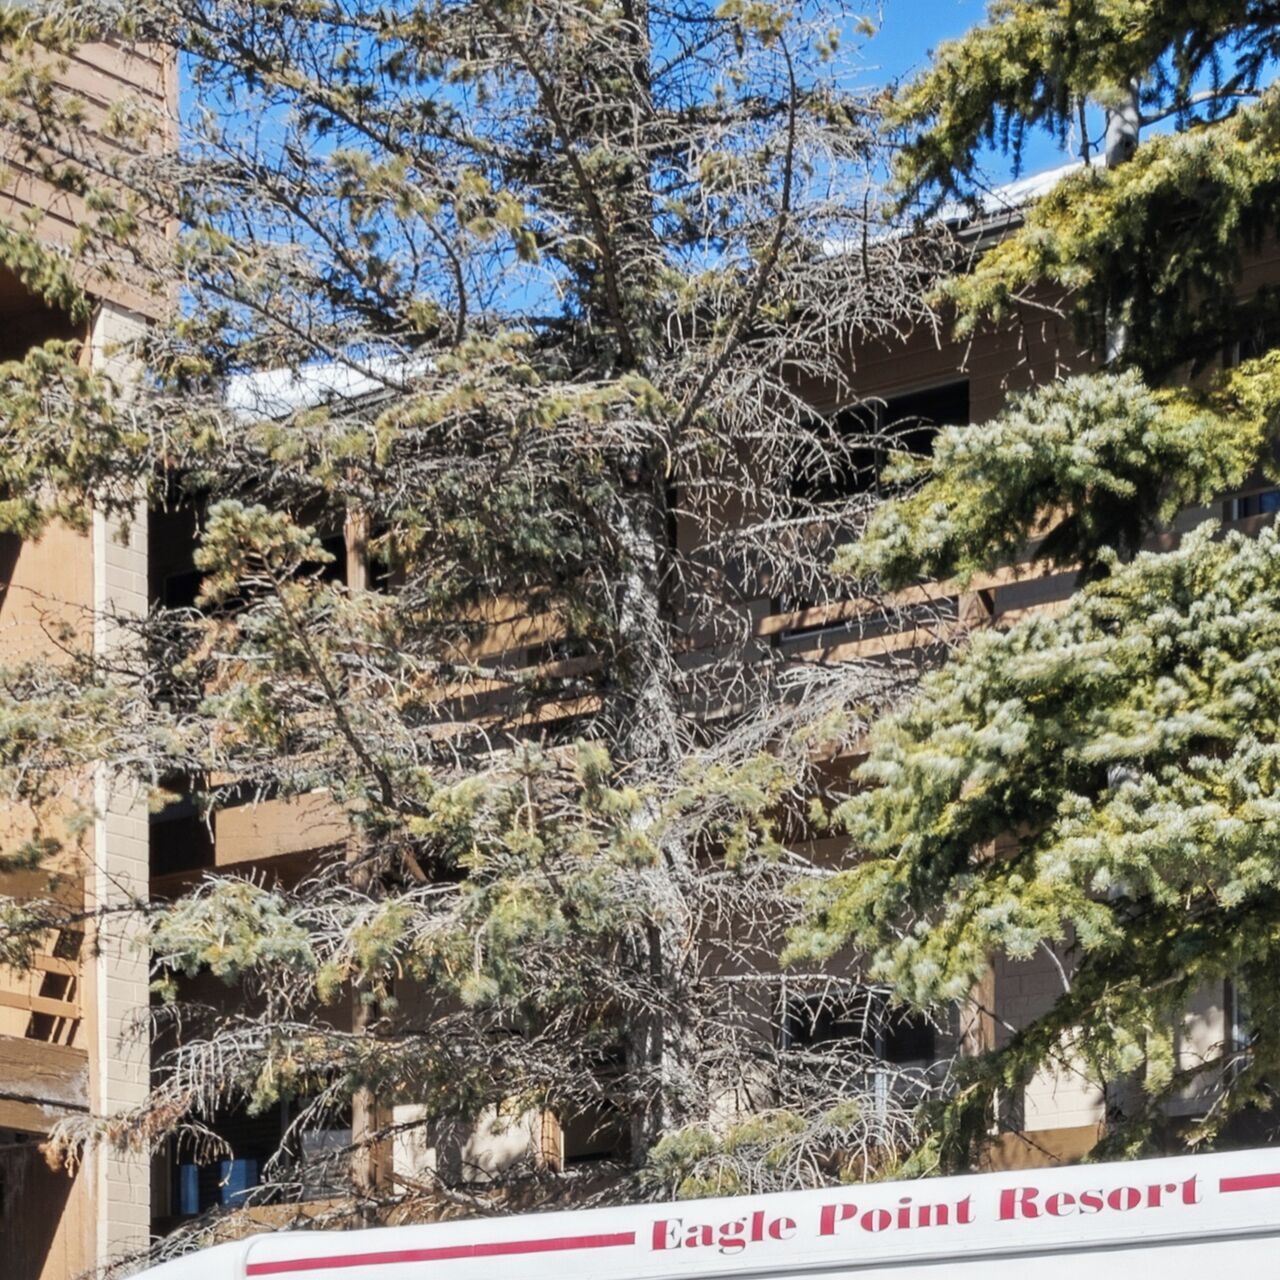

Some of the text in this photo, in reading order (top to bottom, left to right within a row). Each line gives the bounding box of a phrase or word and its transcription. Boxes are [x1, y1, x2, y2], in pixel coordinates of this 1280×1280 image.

[649, 1174, 1204, 1255] Eagle Point Resort
